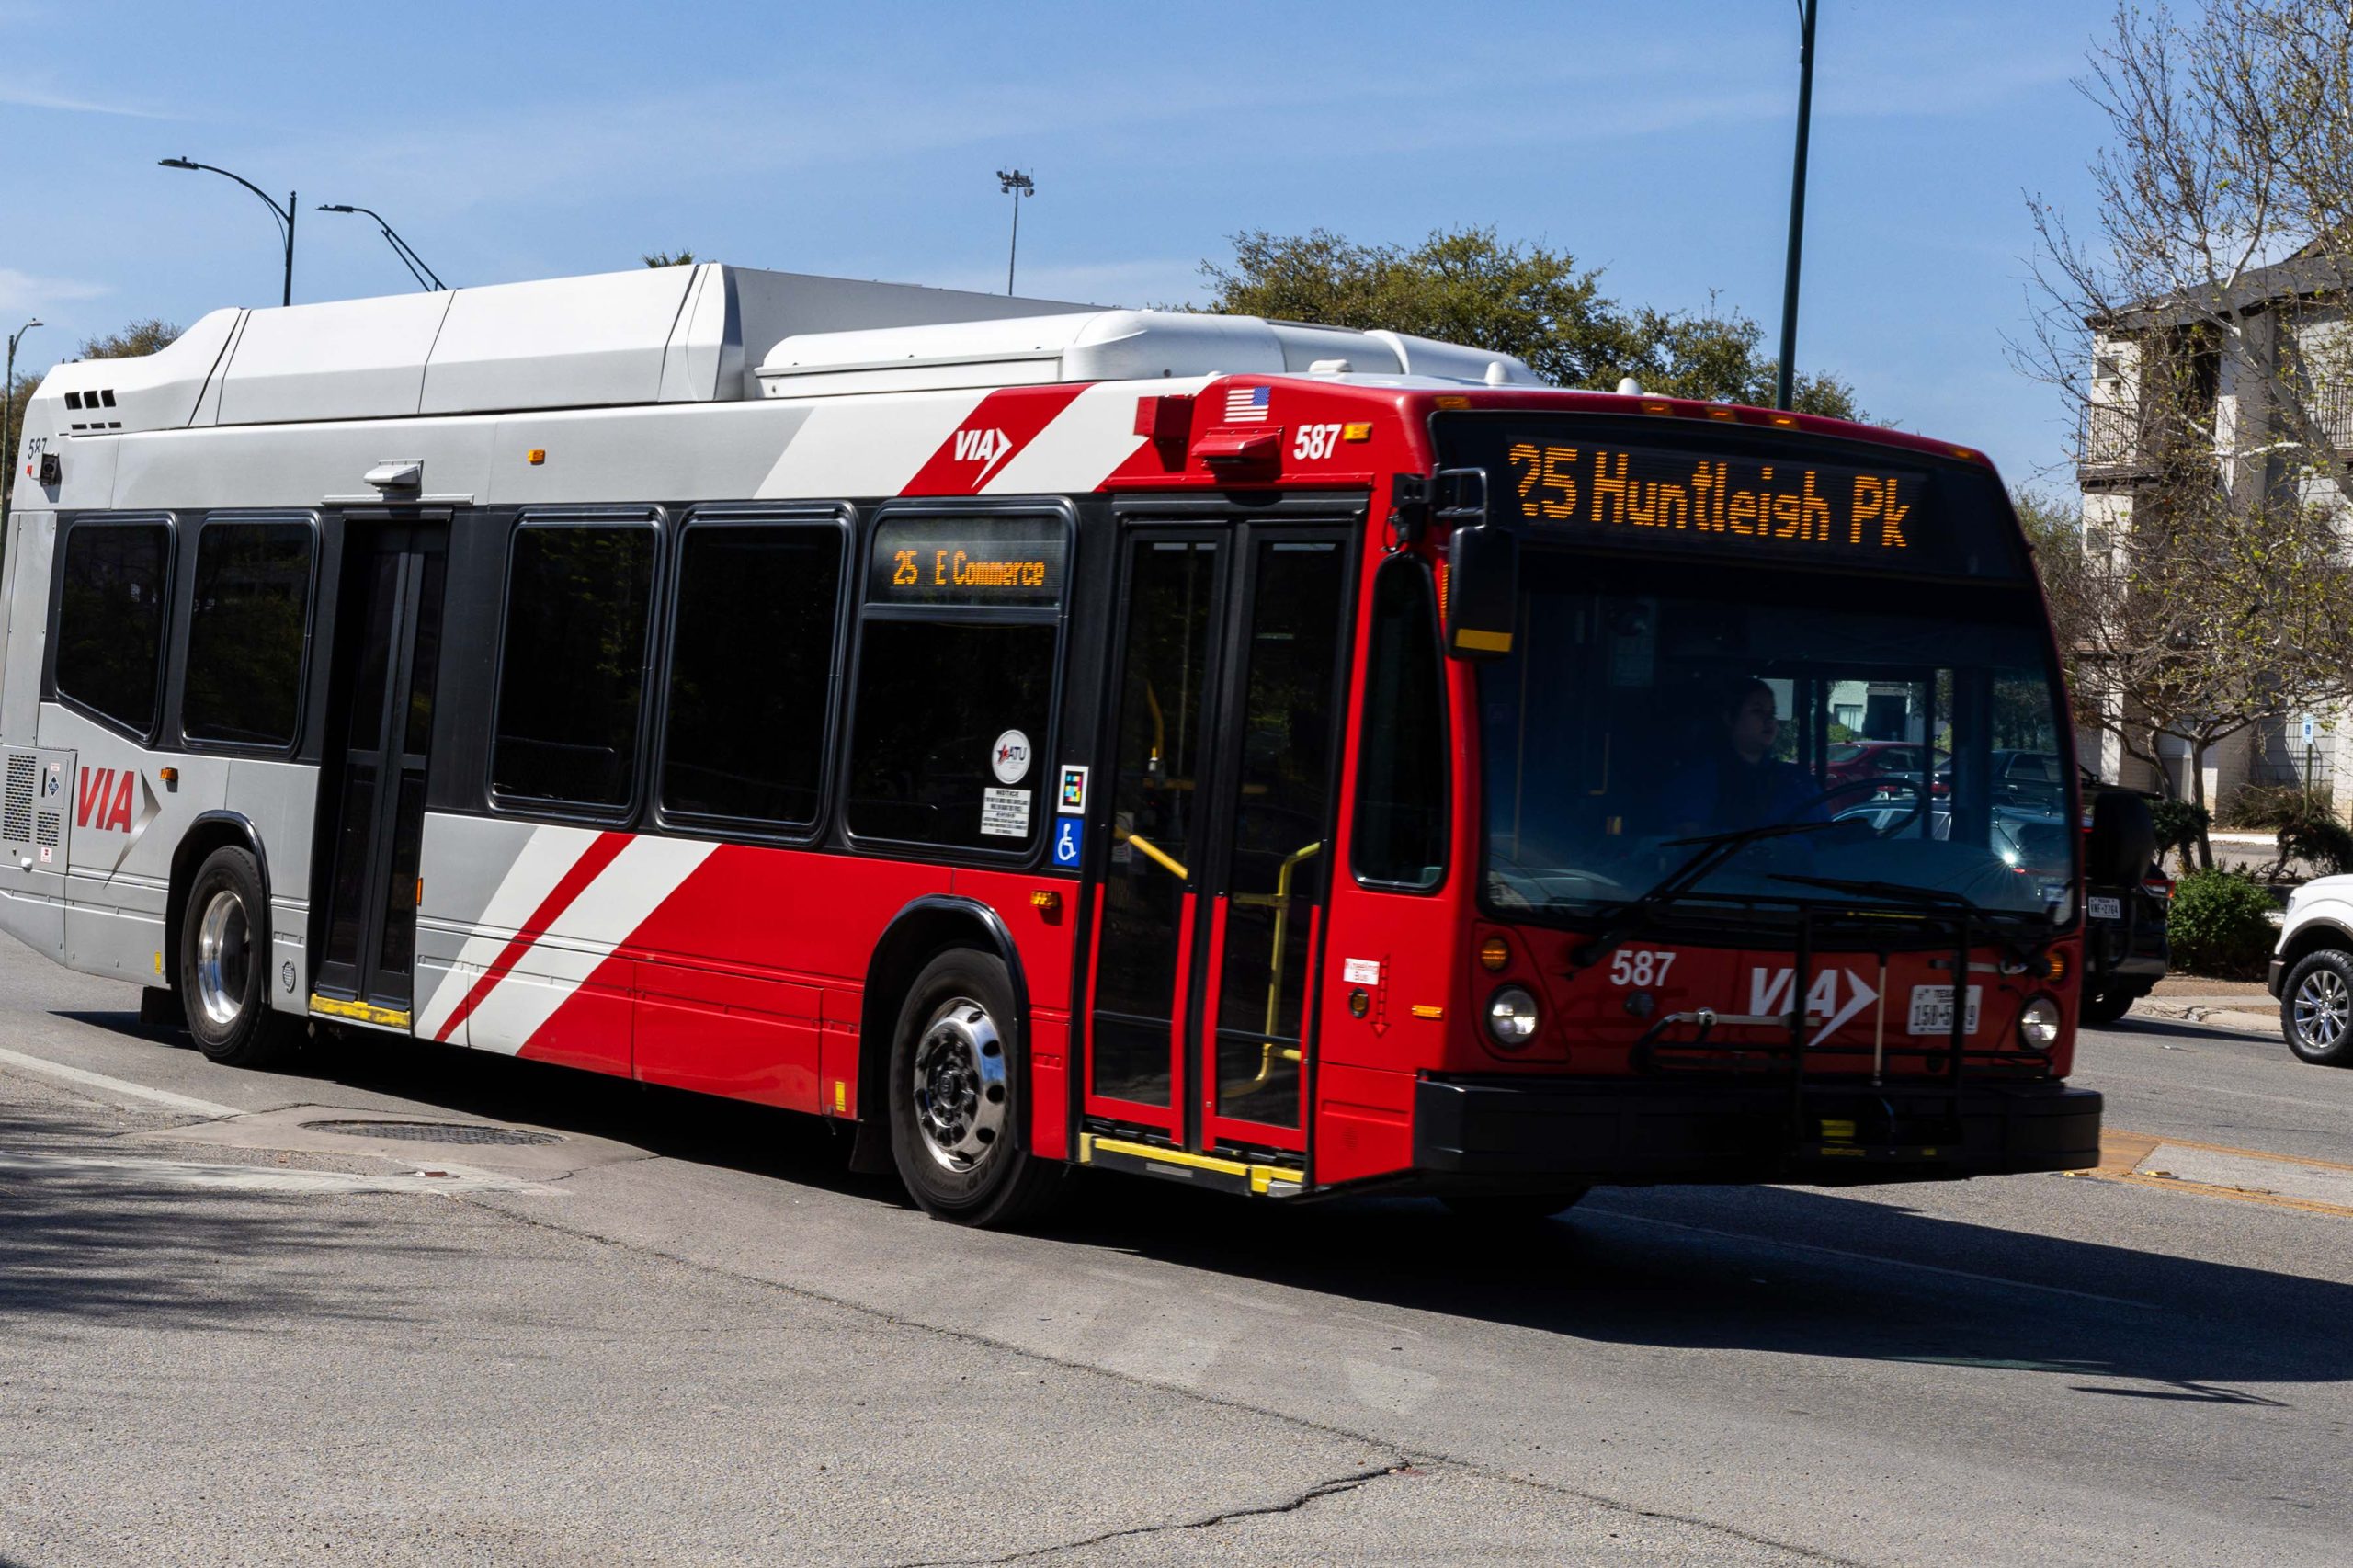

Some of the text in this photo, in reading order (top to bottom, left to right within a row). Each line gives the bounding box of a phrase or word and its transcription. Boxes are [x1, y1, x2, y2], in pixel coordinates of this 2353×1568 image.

[954, 429, 995, 461] VIA
[1293, 423, 1343, 460] 587
[1508, 443, 1910, 548] 25 Huntleigh Pk
[893, 550, 1045, 585] 25 E Commerce
[1008, 746, 1028, 761] ATU
[77, 766, 135, 834] VIA
[1609, 950, 1677, 987] 587
